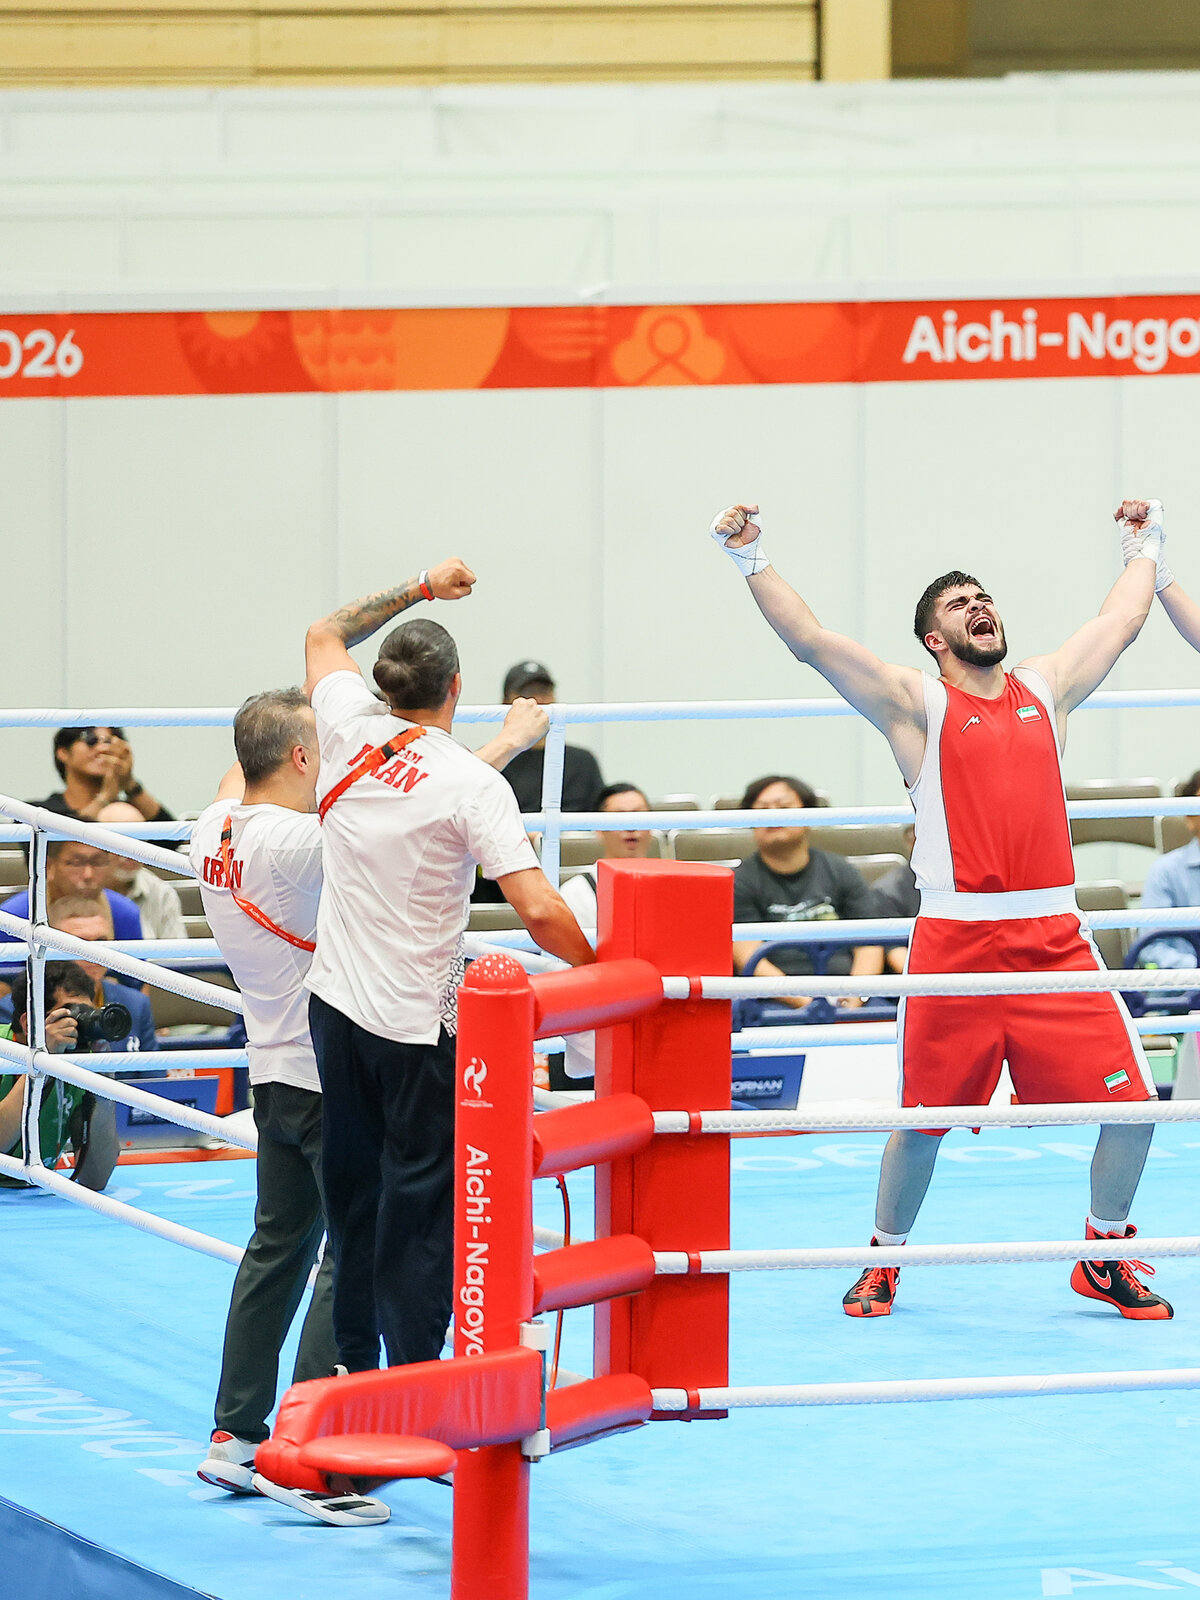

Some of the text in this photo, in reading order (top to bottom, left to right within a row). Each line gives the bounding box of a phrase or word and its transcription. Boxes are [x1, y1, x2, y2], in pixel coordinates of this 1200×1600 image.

[0, 328, 84, 379] 026
[347, 743, 430, 793] IAN
[203, 856, 243, 889] IRN
[731, 1079, 784, 1093] ORNAN
